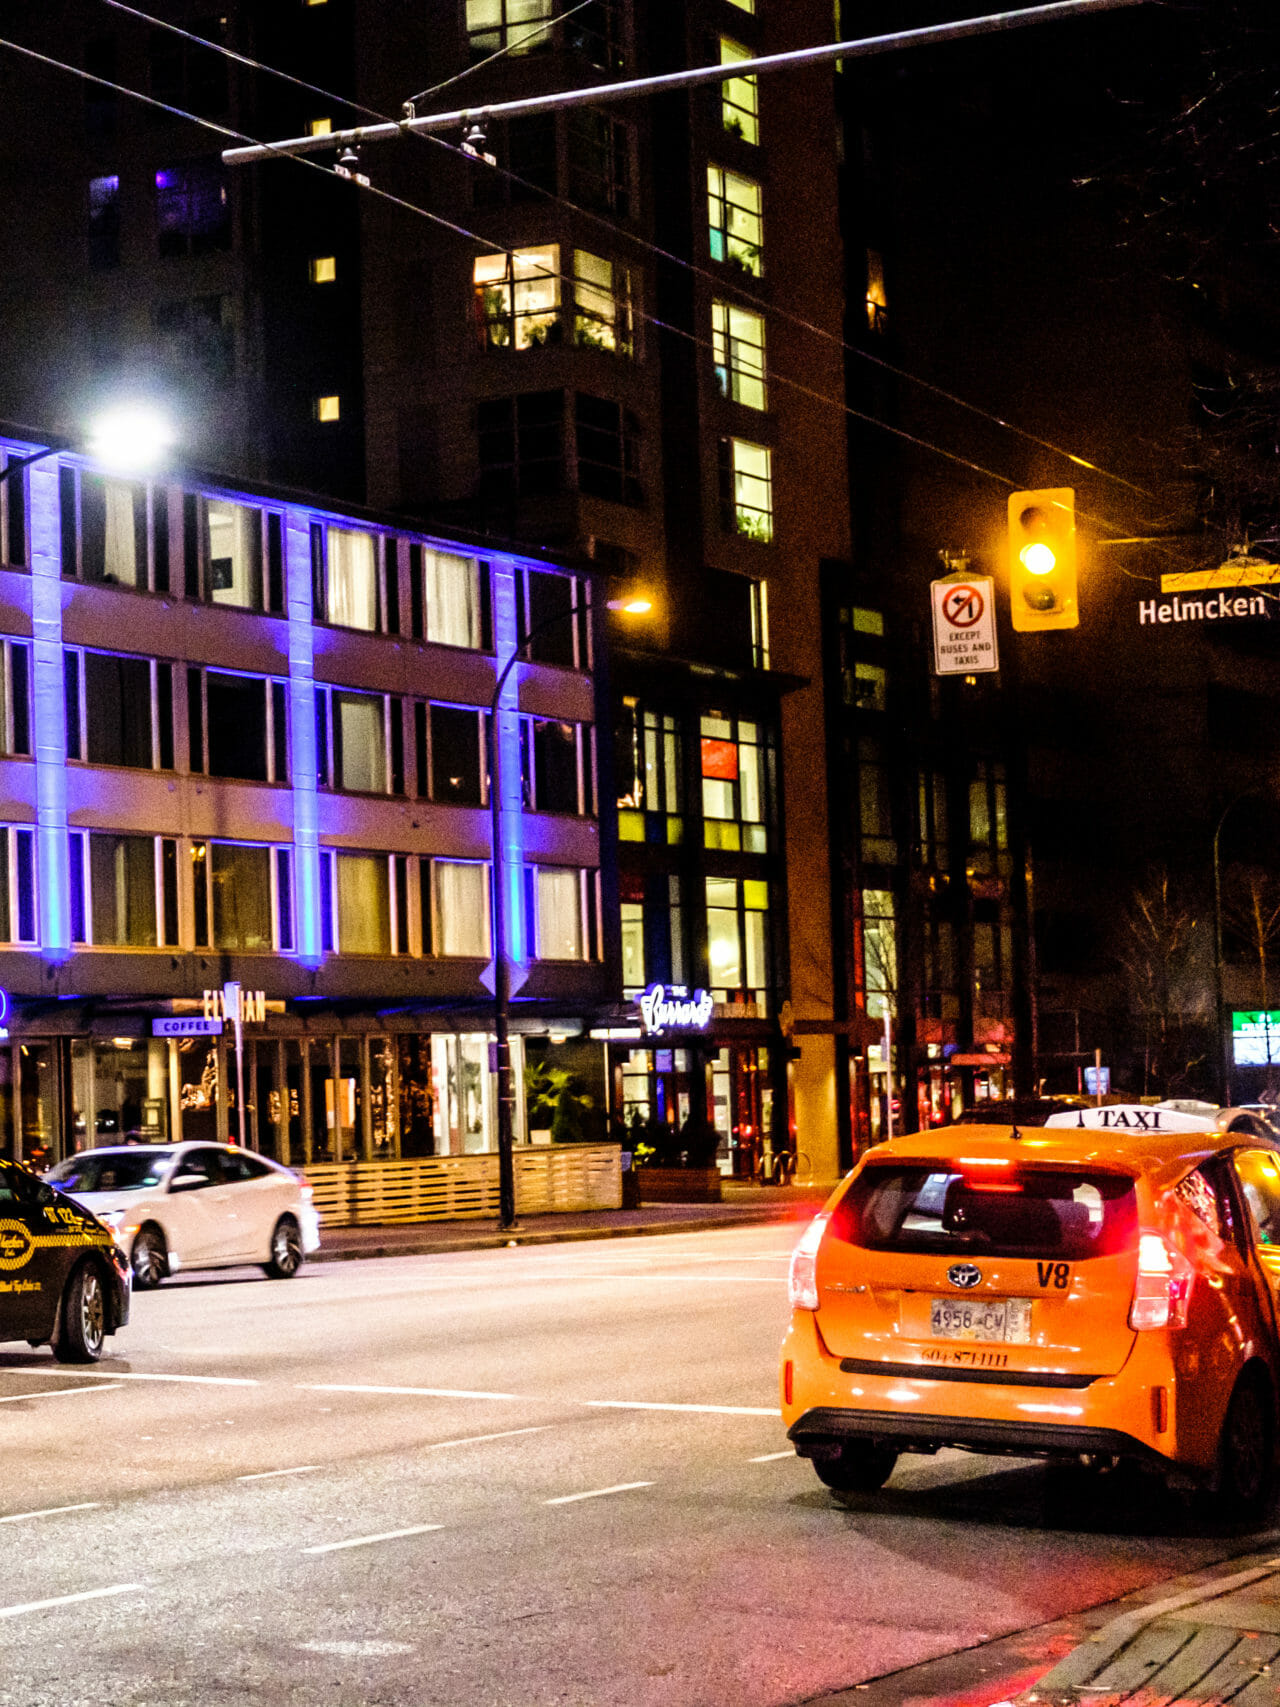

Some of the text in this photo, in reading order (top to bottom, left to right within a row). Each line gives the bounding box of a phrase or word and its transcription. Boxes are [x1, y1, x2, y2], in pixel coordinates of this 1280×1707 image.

[1139, 592, 1266, 625] Helmcken
[949, 630, 981, 642] EXCEPT
[940, 641, 991, 655] BUSES AND
[954, 655, 979, 666] TAXIS
[163, 1021, 210, 1032] COFFEE
[1098, 1110, 1163, 1129] TAXI
[1036, 1262, 1070, 1290] V8
